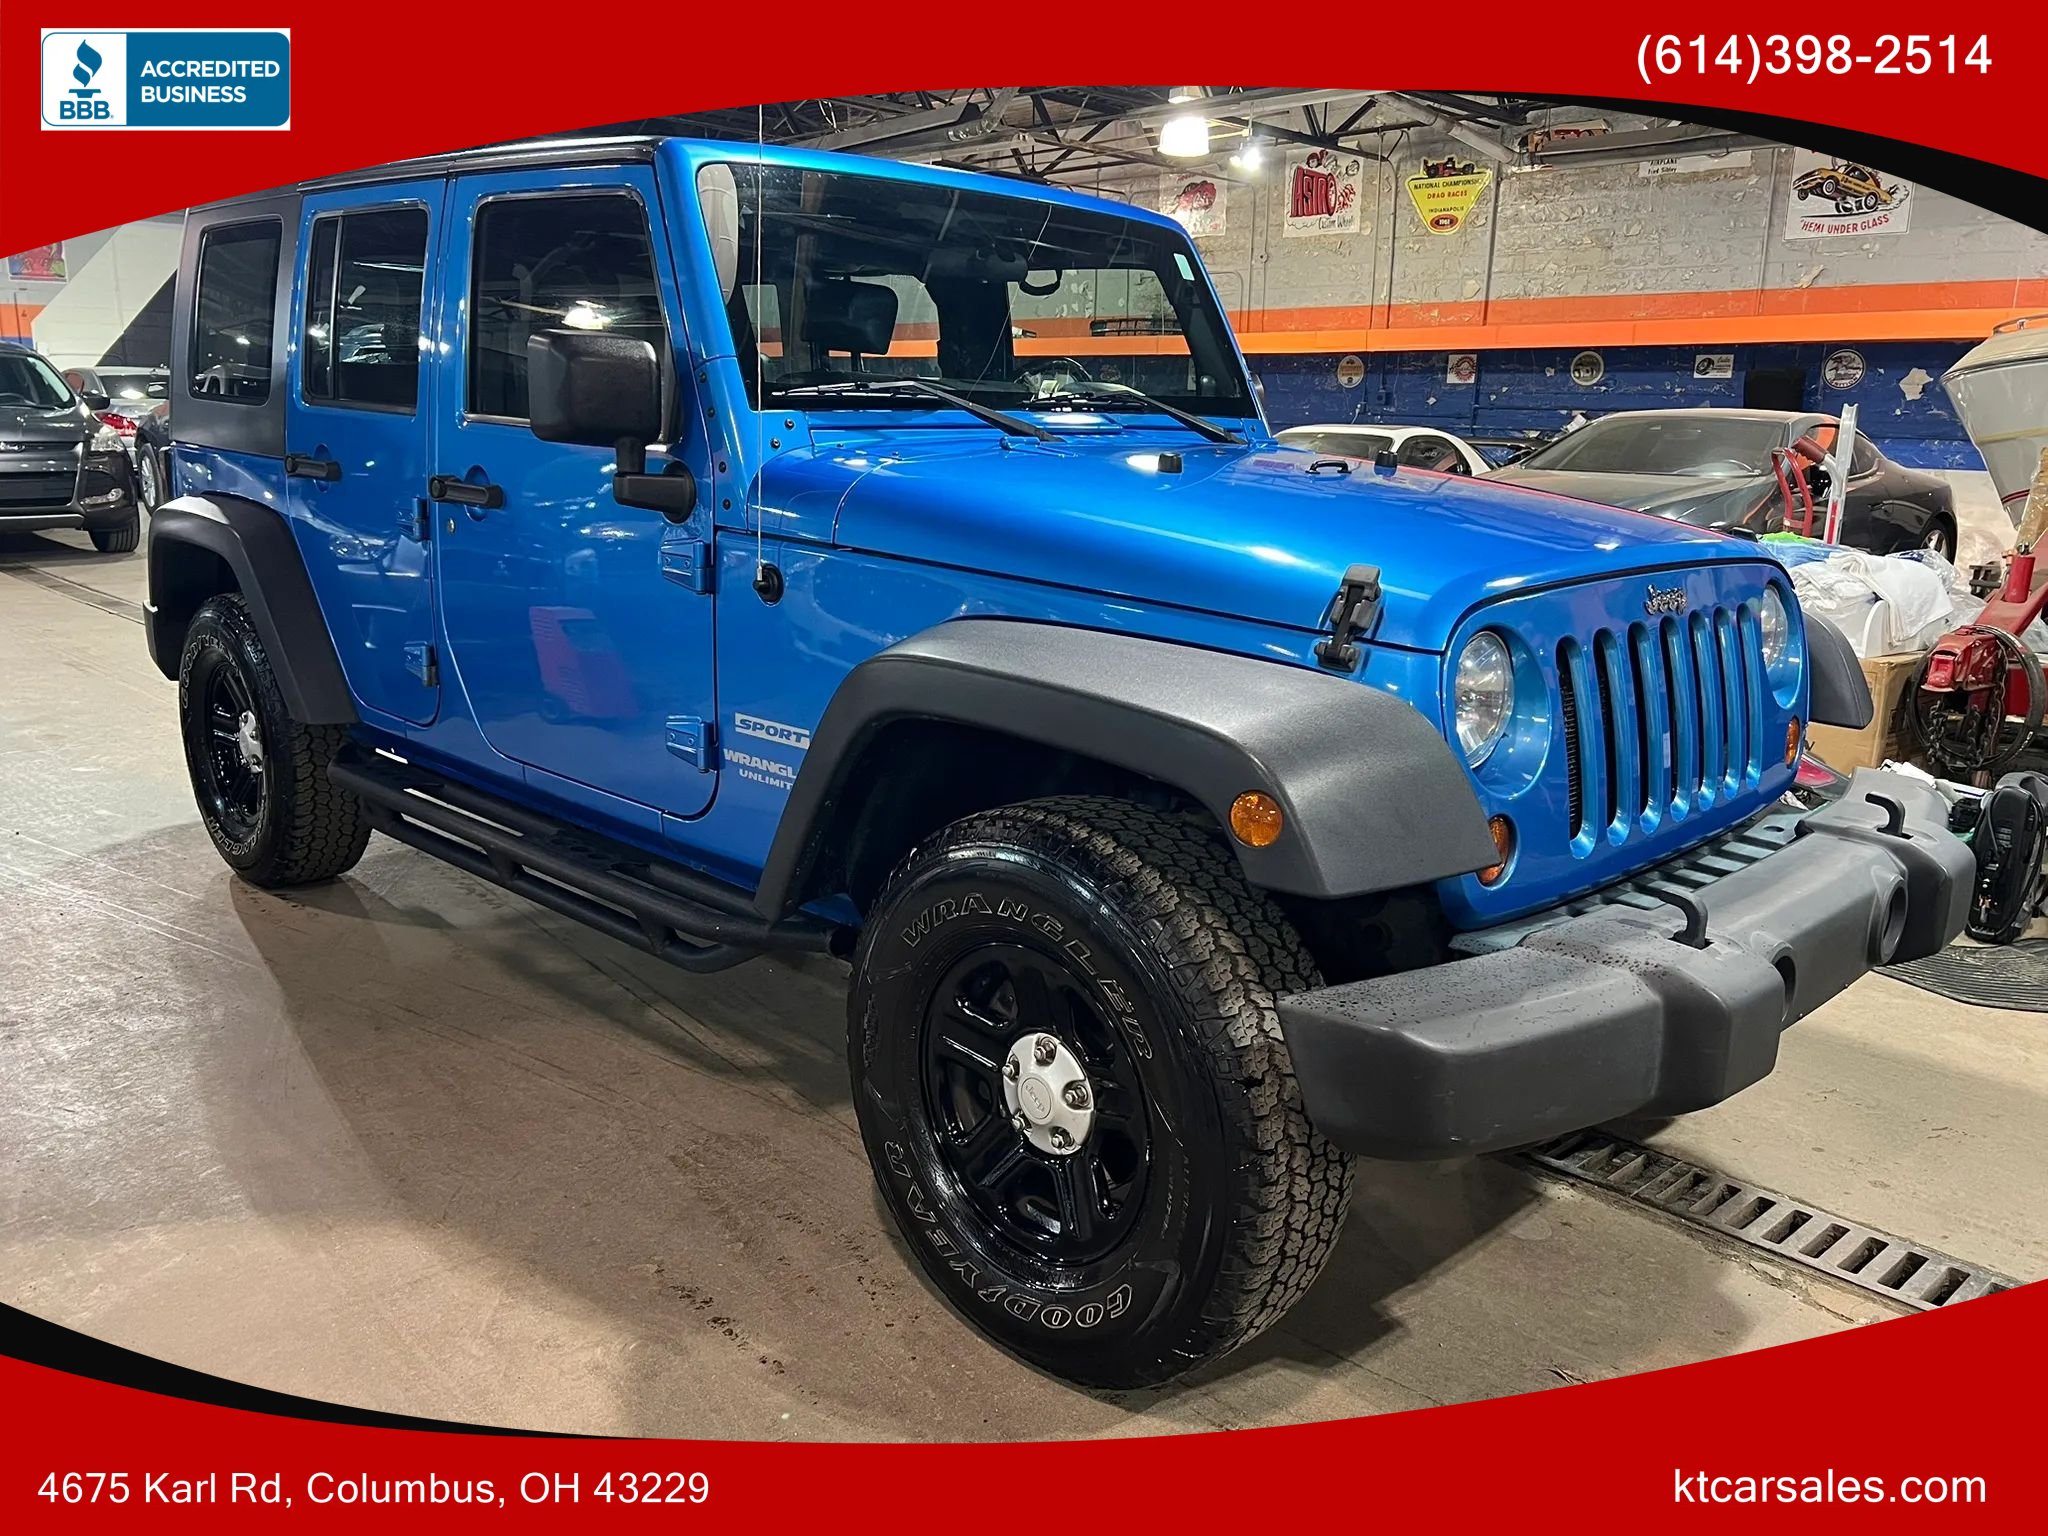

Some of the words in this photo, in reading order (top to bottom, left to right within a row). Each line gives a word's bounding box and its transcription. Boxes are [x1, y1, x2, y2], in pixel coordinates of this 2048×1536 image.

[1448, 190, 1467, 198] RACES
[1828, 223, 1858, 234] UNDER
[1645, 584, 1687, 615] Jeep
[737, 718, 808, 744] SPORT
[901, 892, 1152, 1060] WRANGLER
[883, 1140, 1132, 1329] GOODYEAR
